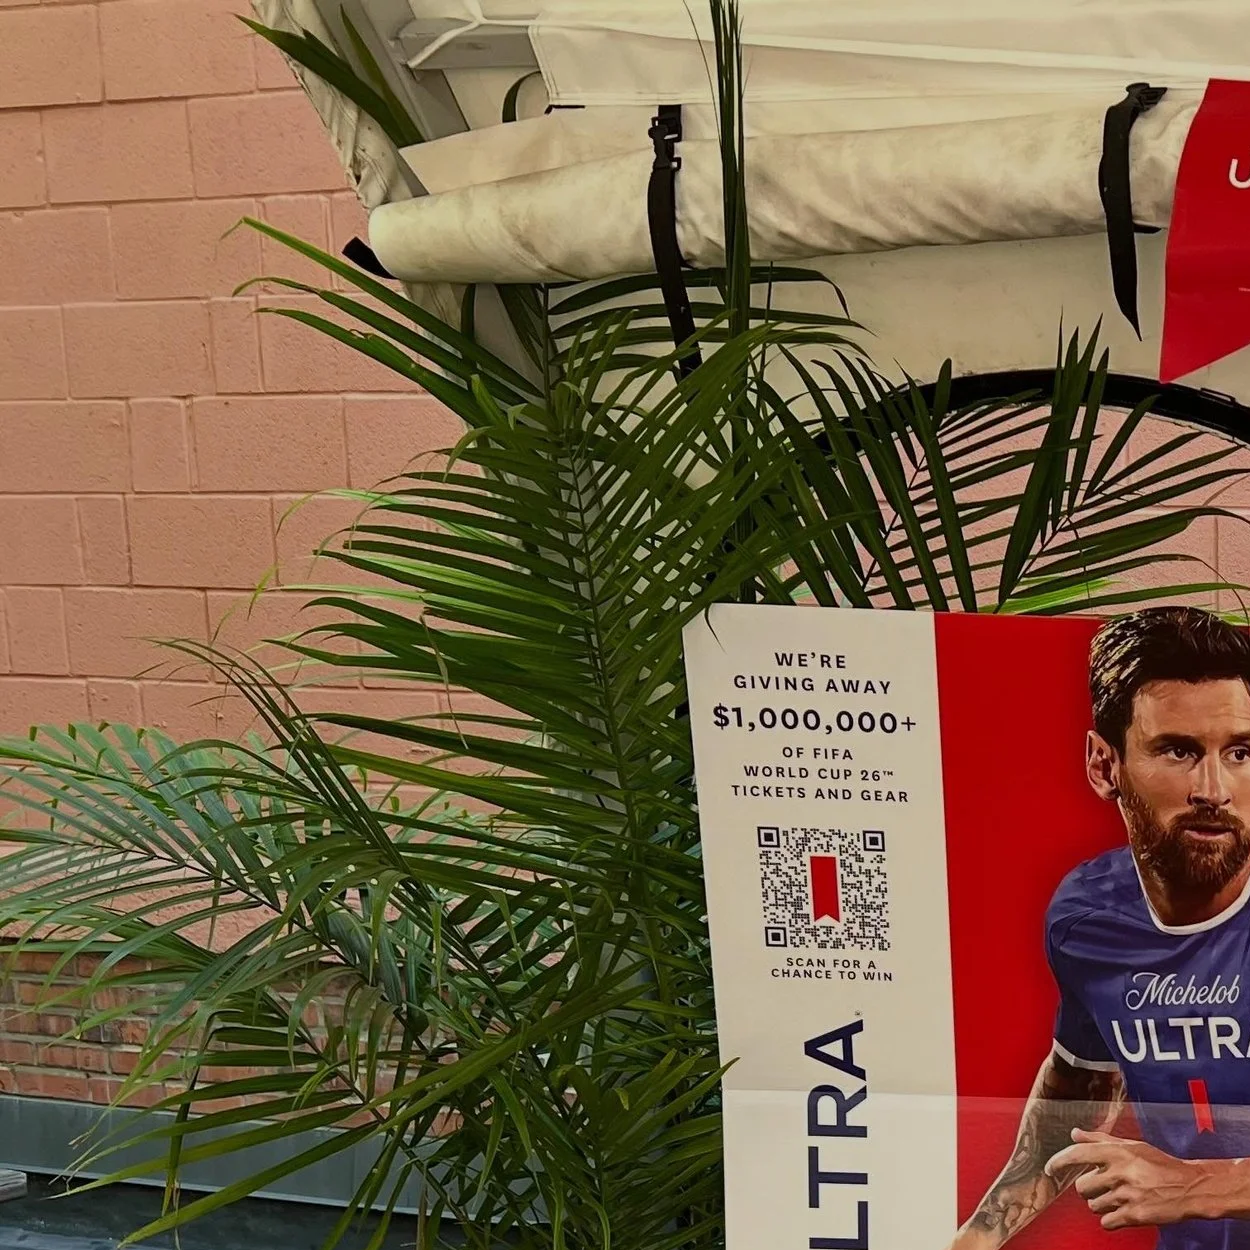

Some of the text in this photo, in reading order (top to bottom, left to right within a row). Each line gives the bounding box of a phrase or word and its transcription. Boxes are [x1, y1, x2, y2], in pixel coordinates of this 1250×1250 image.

[733, 674, 892, 695] GIVING AWAY
[712, 703, 917, 734] $1,000,000+
[782, 746, 853, 761] OF FIFA
[743, 765, 809, 779] WORLD
[817, 768, 853, 781] CUP
[731, 785, 909, 803] TICKETS AND GEAR
[786, 957, 877, 970] SCAN FOR A
[771, 968, 893, 982] CHANCE TO WIN
[1125, 971, 1240, 1011] Michelob
